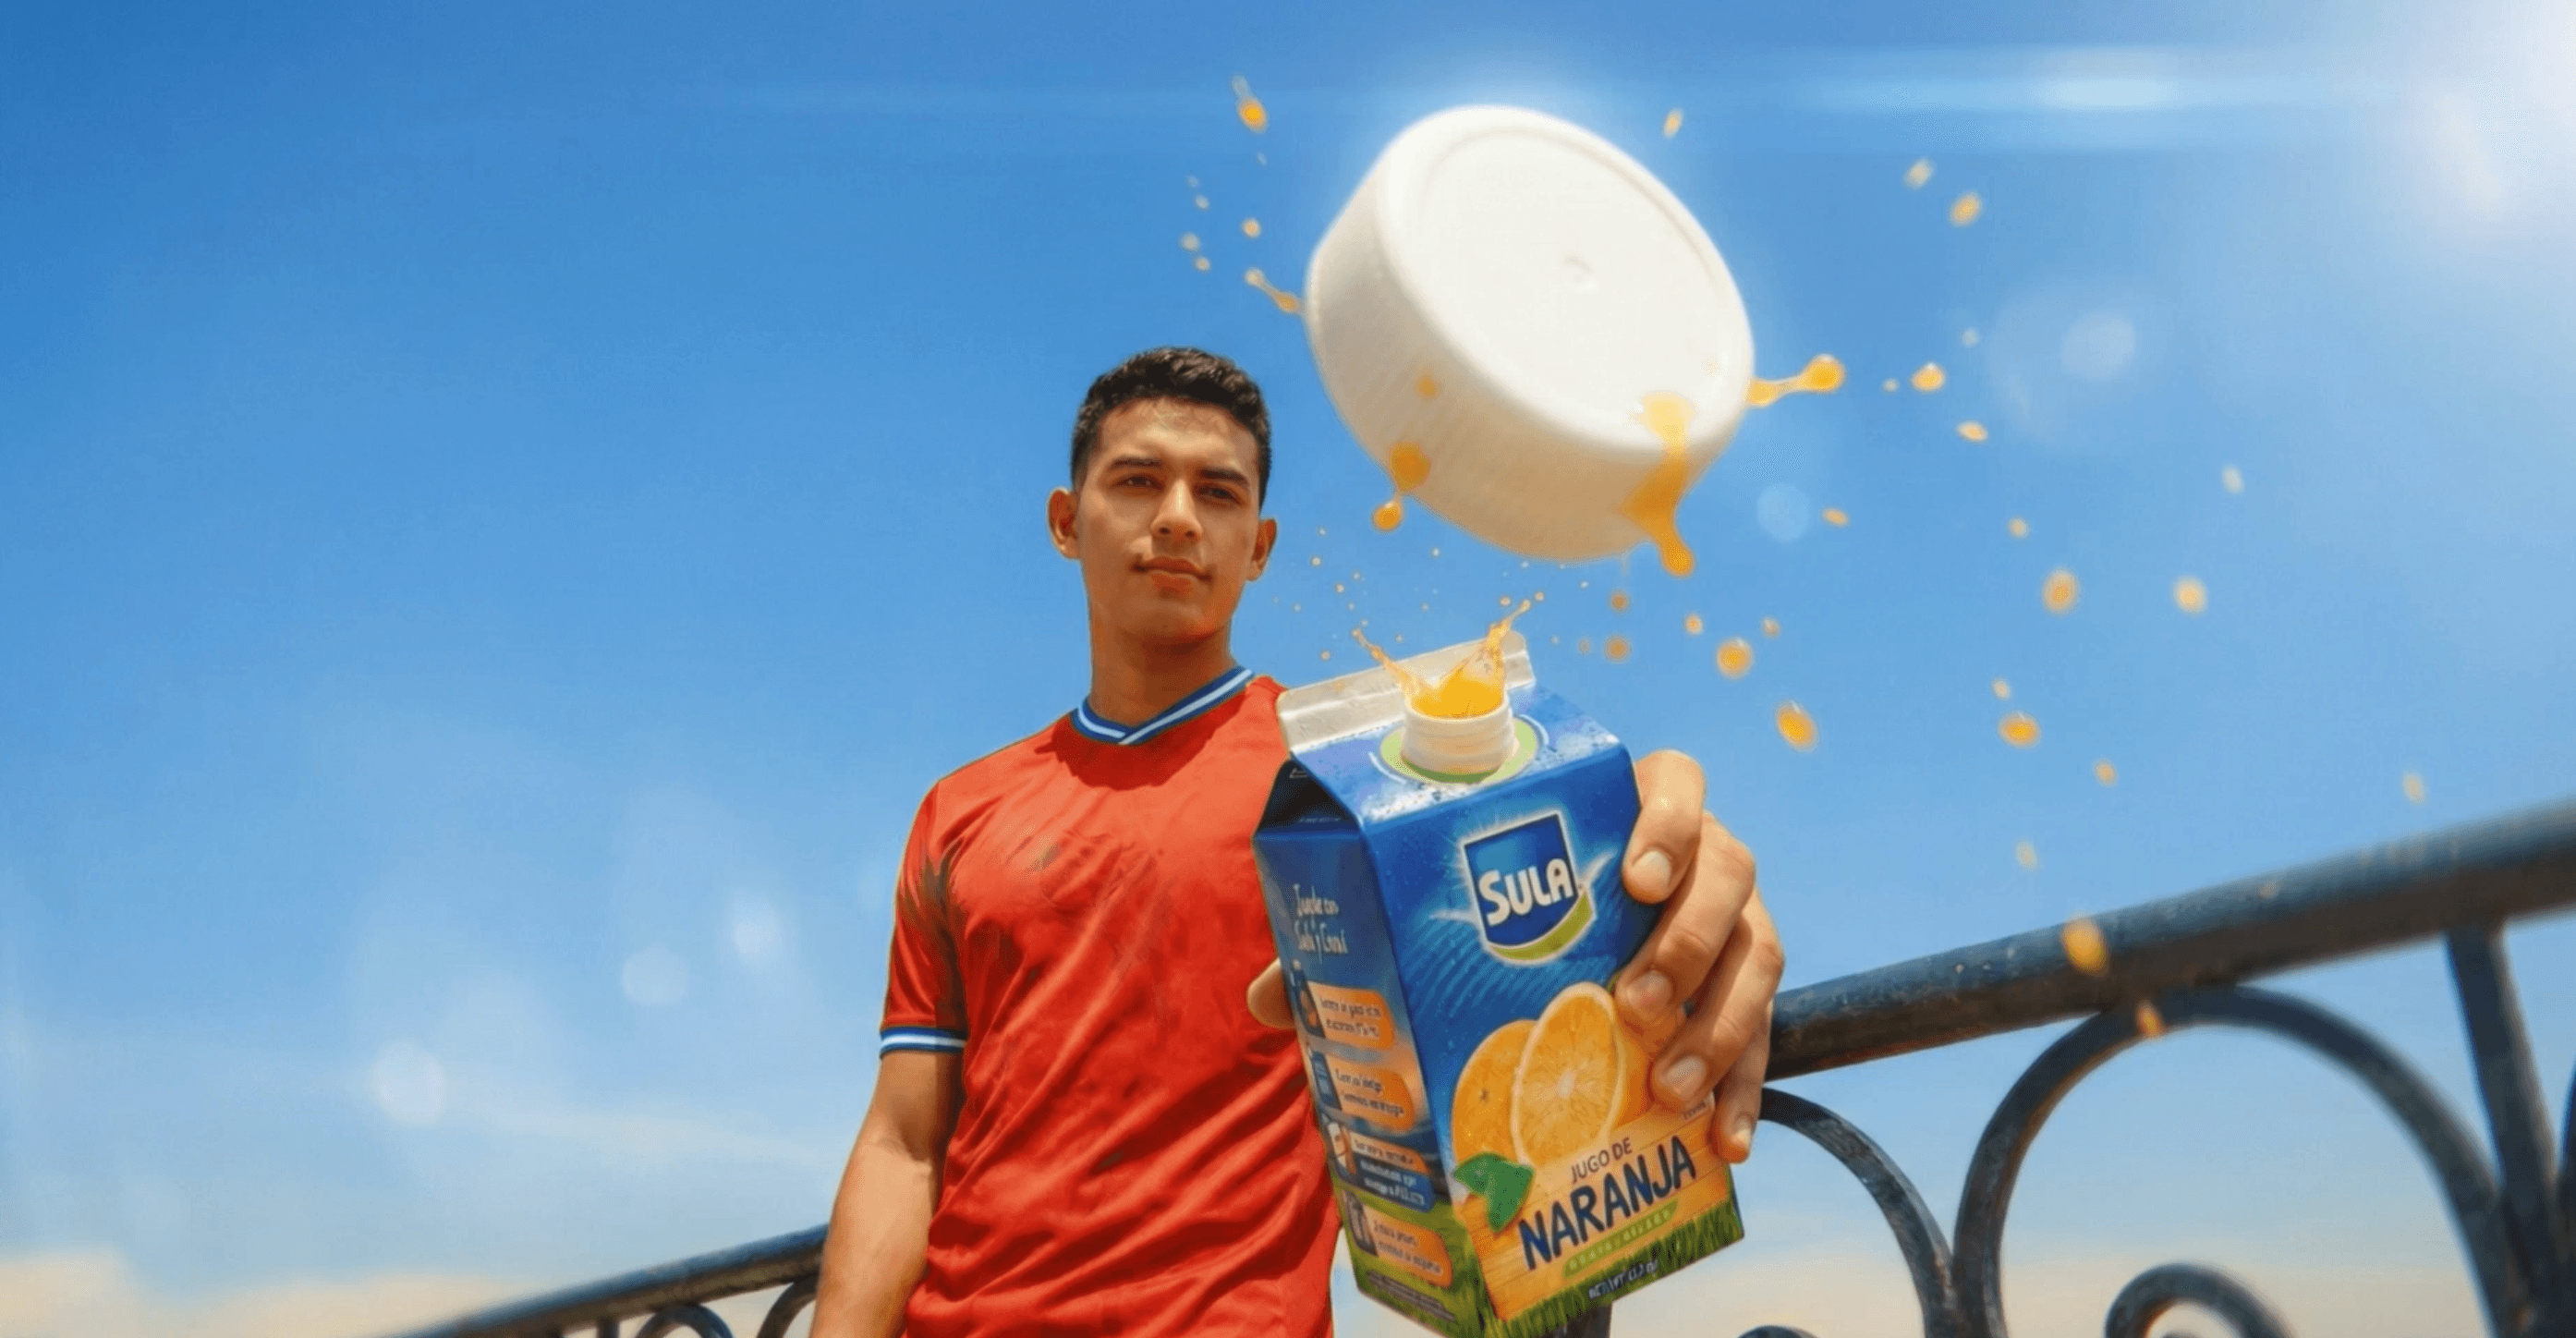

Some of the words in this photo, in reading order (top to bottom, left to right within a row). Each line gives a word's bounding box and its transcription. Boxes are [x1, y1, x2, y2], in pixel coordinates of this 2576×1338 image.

[1478, 858, 1574, 927] SULA
[1571, 1149, 1610, 1185] JUGO
[1610, 1137, 1634, 1162] DE
[1517, 1134, 1697, 1271] NARANJA
